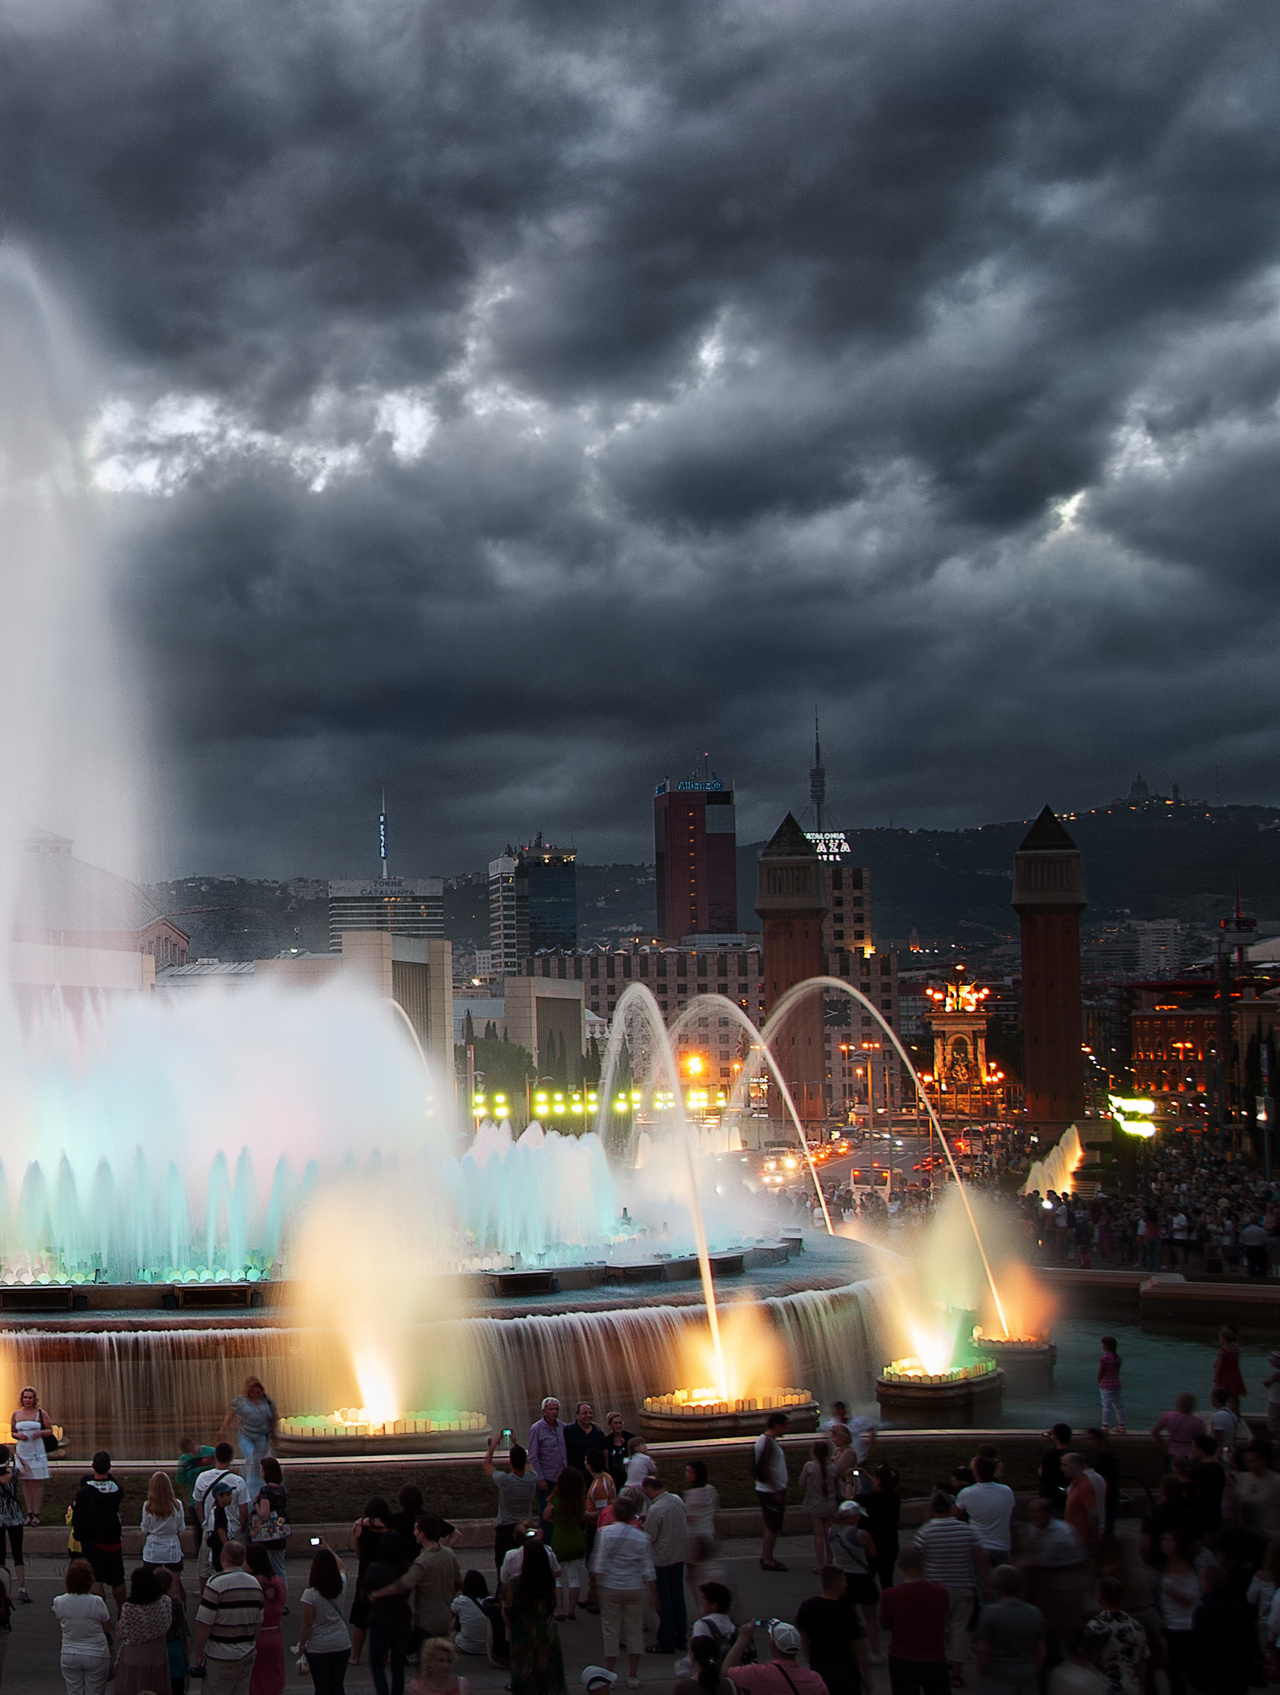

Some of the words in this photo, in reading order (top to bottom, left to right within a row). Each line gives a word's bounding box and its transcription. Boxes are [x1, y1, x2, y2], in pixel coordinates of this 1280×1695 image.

[677, 781, 711, 790] Allianz
[816, 842, 851, 853] AZA
[372, 880, 404, 888] TORRE
